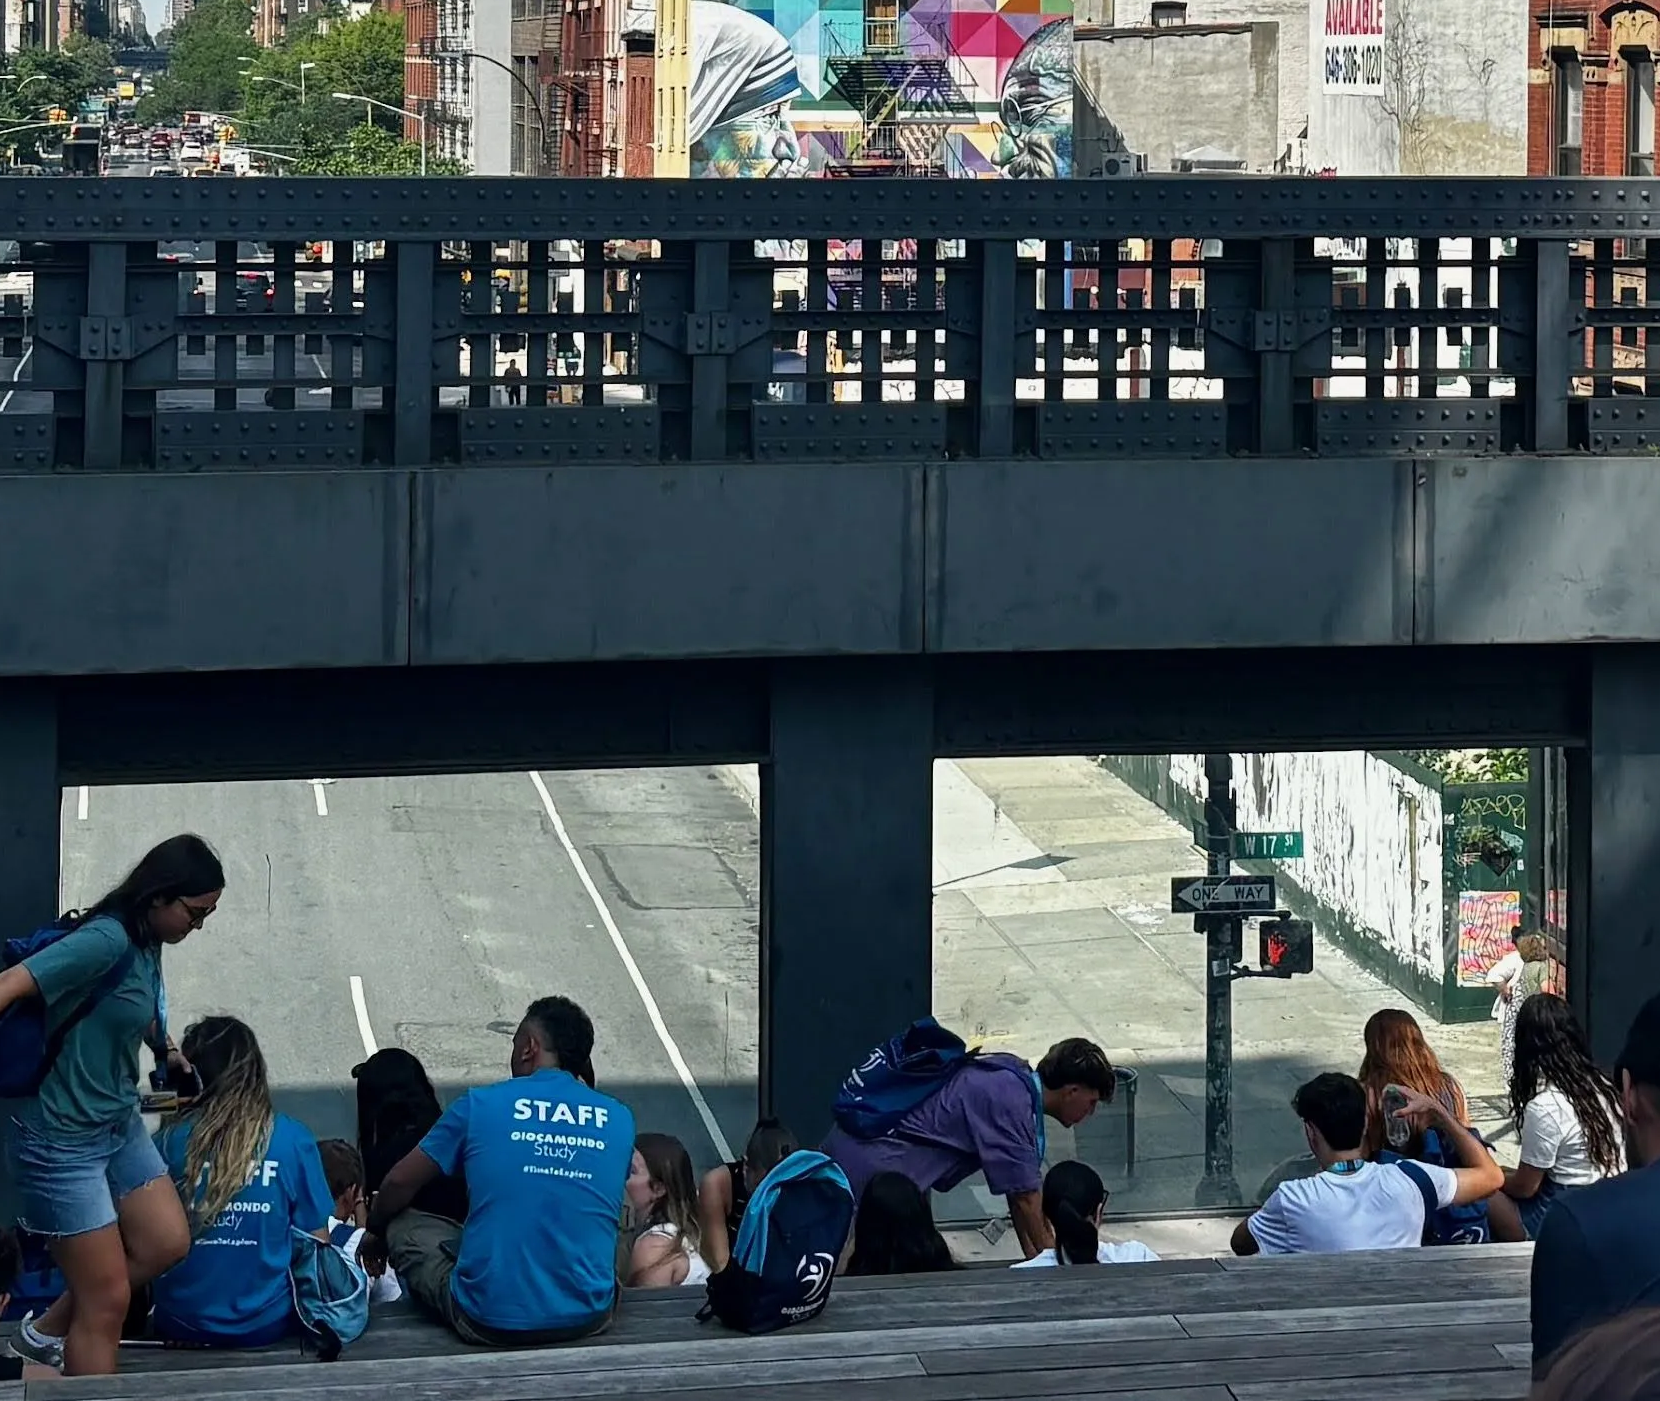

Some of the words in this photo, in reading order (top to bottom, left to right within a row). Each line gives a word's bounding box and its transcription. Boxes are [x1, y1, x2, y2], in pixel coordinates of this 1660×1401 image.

[1244, 835, 1256, 856] W
[1262, 835, 1277, 855] 17
[1192, 887, 1219, 901] ONE
[1234, 886, 1264, 899] WAY
[513, 1098, 608, 1129] STAFF
[510, 1131, 606, 1151] GIOCAMONDO
[534, 1141, 578, 1163] Study
